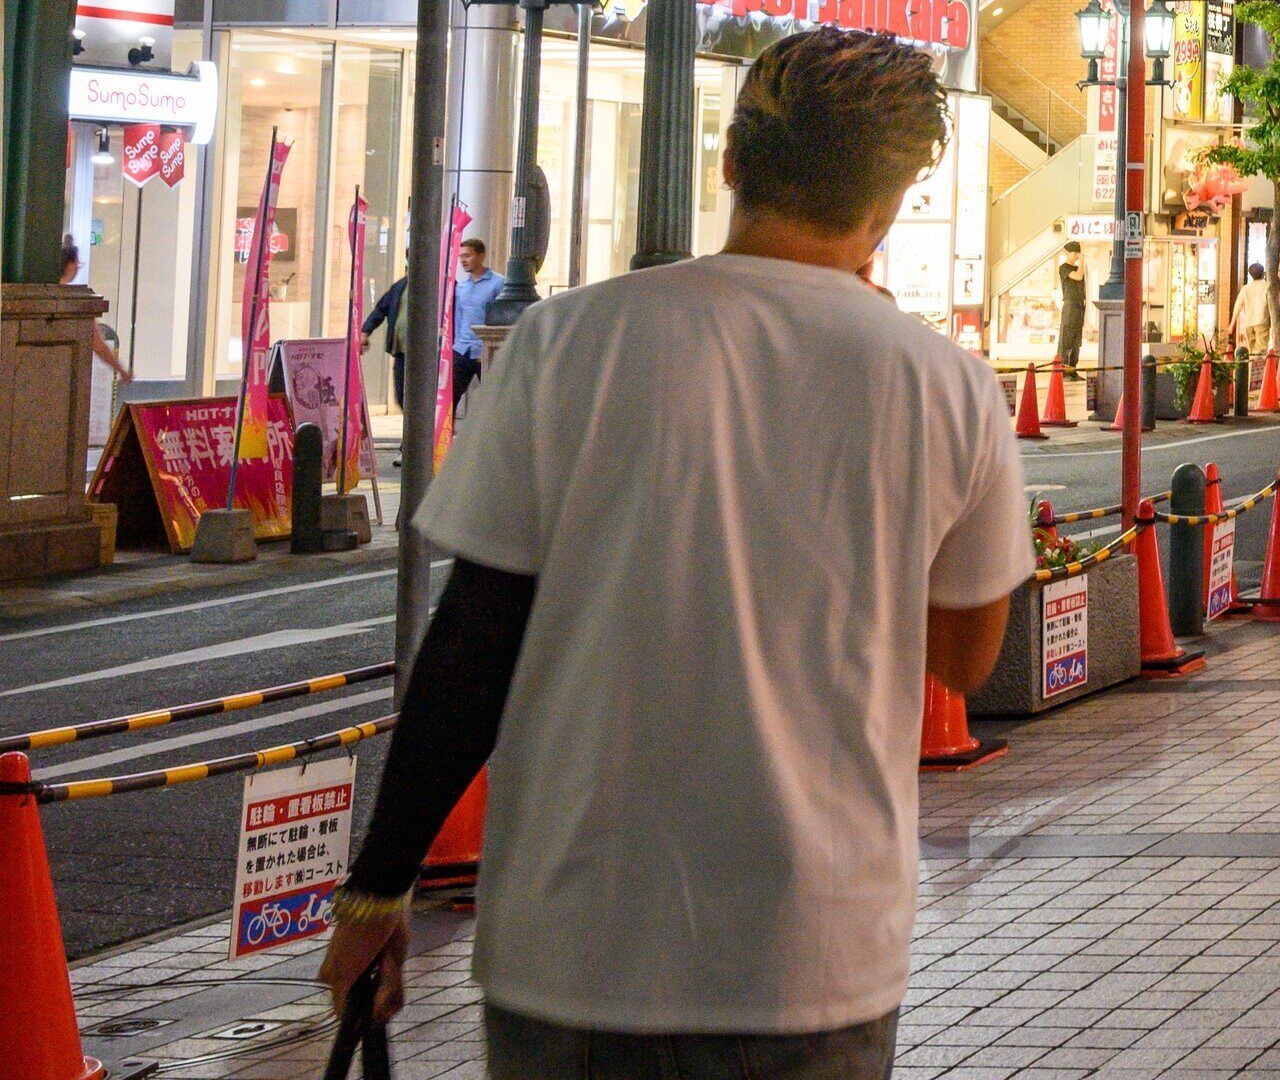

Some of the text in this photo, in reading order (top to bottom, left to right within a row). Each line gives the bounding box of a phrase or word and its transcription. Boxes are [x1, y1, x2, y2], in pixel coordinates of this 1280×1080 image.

[155, 419, 294, 474] 無料案所
[249, 788, 348, 827] 駐輪・置看板禁止
[246, 818, 339, 853] 無断にて駐輪・看板
